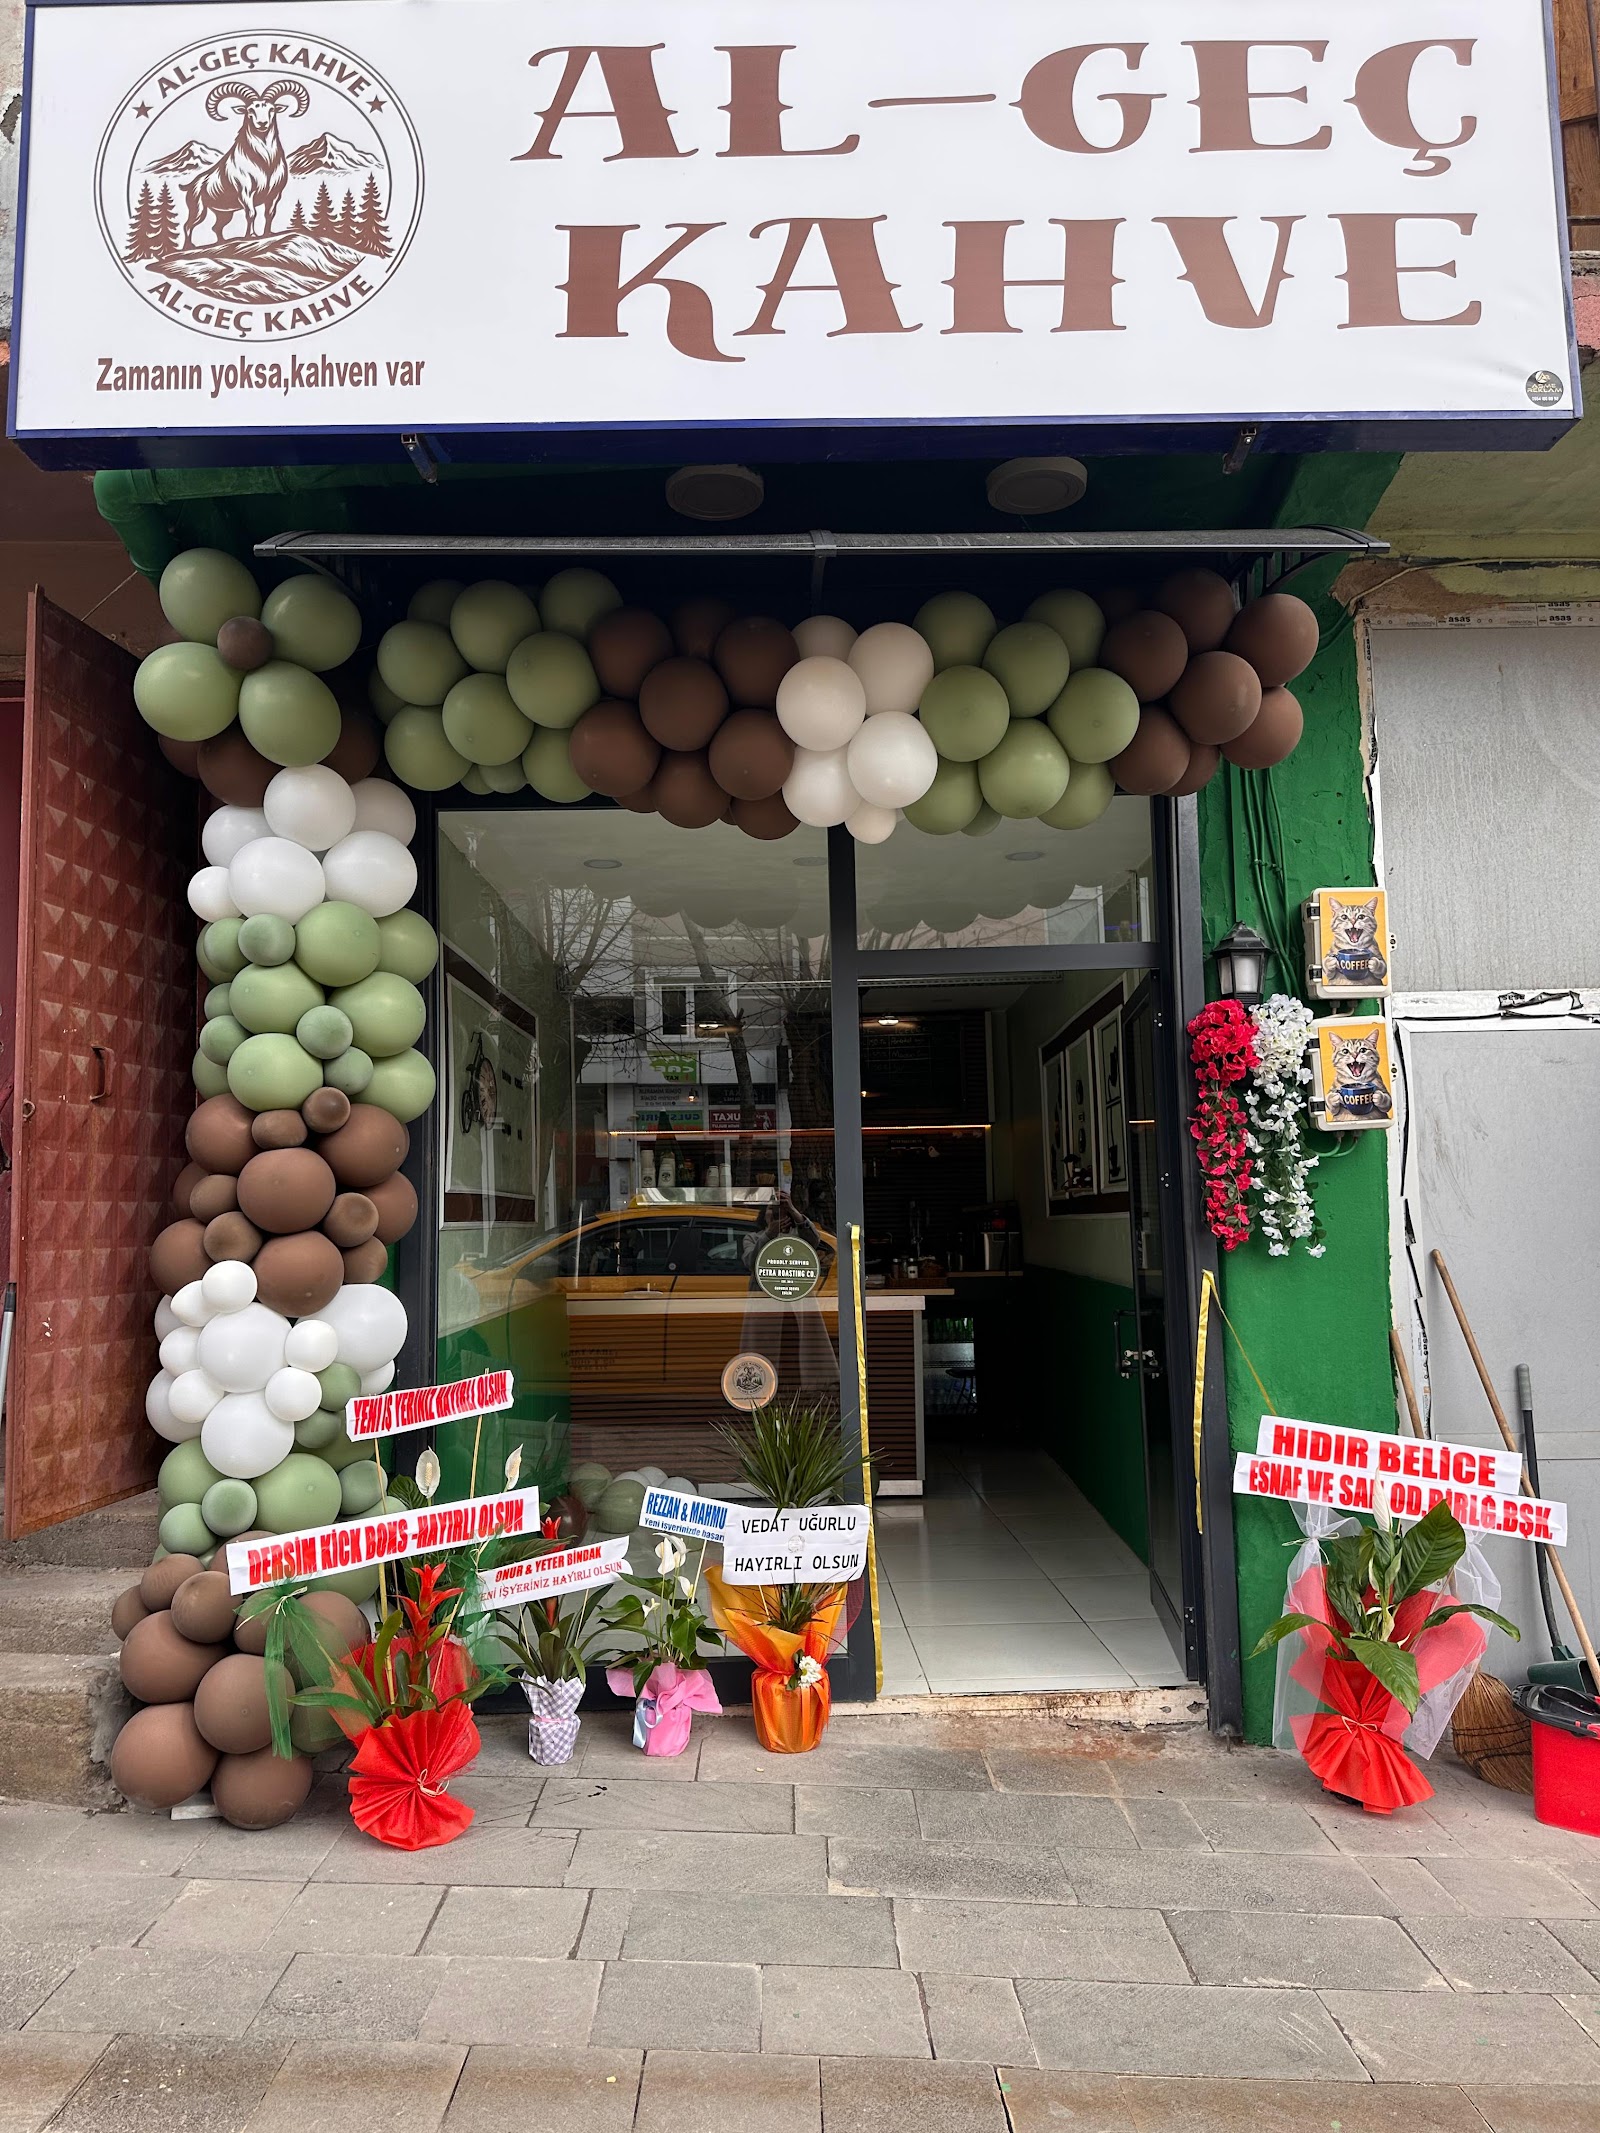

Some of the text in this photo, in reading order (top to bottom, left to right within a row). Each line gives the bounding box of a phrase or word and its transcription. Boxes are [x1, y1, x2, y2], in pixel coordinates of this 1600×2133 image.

[156, 43, 372, 100] AL-GEÇ KAHVE
[147, 274, 374, 338] AL-GEÇ KAHVE
[555, 213, 1482, 362] KAHVE
[96, 357, 202, 391] Zamanın
[386, 360, 425, 387] var
[1341, 959, 1369, 970] COFFEE
[759, 1268, 816, 1278] PETRA ROASTING CO.
[436, 1378, 477, 1418] HAYIRLI
[477, 1372, 508, 1408] OLSUN
[1273, 1424, 1496, 1488] HIDIR BELİCE
[1249, 1460, 1303, 1499] ESNAF
[1307, 1469, 1334, 1503] VE
[644, 1517, 660, 1527] Yeni
[646, 1492, 728, 1530] REZZAN & MAHMU
[742, 1513, 856, 1534] VEDAT UĞURLU
[248, 1536, 318, 1586] DERSİM
[320, 1528, 362, 1570] KİCK
[365, 1517, 408, 1561] BOKS
[478, 1499, 524, 1538] OLSUN
[480, 1561, 622, 1602] ENİ İŞYERİNİZ HAYIRLI OLSUN
[495, 1546, 602, 1583] ONUR & YETER BİNDAK
[734, 1553, 859, 1572] HAYIRLI OLSUN
